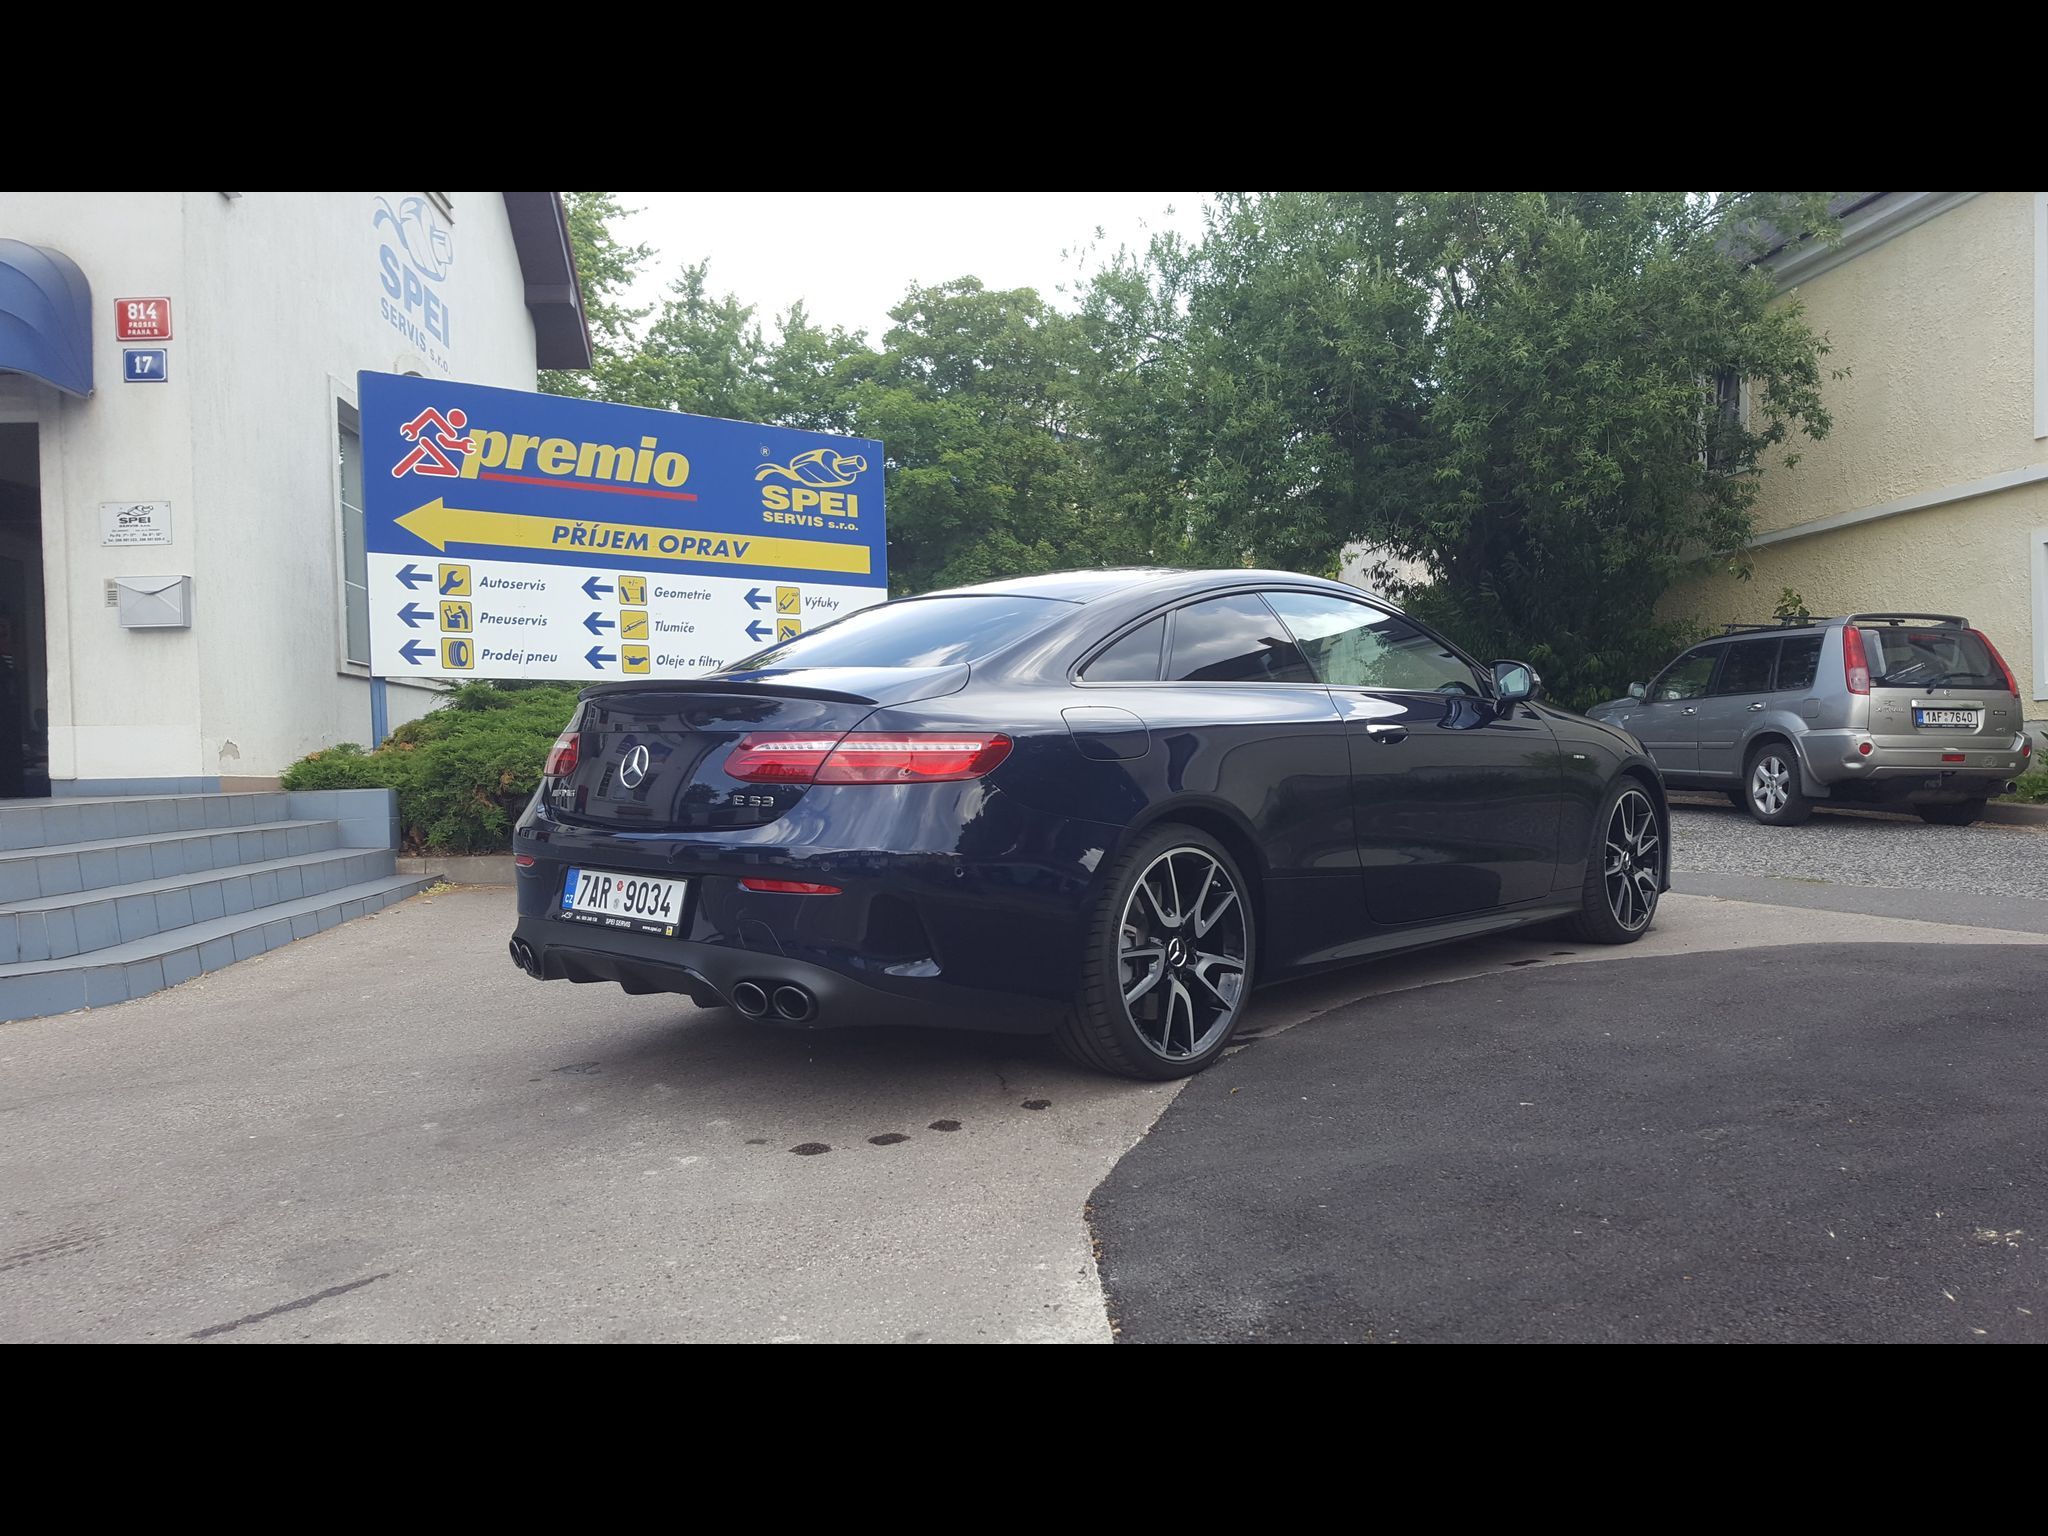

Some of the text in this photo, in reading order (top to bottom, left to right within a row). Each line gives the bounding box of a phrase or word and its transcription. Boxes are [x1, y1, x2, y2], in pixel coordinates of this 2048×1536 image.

[380, 244, 450, 350] SPEI
[128, 302, 157, 320] 814
[381, 297, 451, 375] SERVIS s.r.o.
[134, 355, 153, 375] 17
[459, 428, 690, 487] premio
[762, 485, 858, 518] SPEI
[763, 511, 859, 531] SERVIS s.r.o.
[552, 520, 751, 560] PŘÍJEM OPRAV
[479, 576, 547, 591] Autoservis
[654, 587, 712, 601] Geometrie
[804, 596, 840, 611] Výfuky
[479, 612, 548, 627] Pneuservis
[654, 620, 695, 633] Tlumiče
[481, 649, 558, 664] Prodej pneu
[656, 654, 725, 669] Oleje a filtry
[1925, 712, 1942, 723] 1AF
[1950, 712, 1973, 723] 7640
[732, 795, 774, 807] E 53
[564, 893, 574, 904] CZ
[576, 874, 673, 918] 7AR 9034
[615, 919, 631, 928] SERVIS
